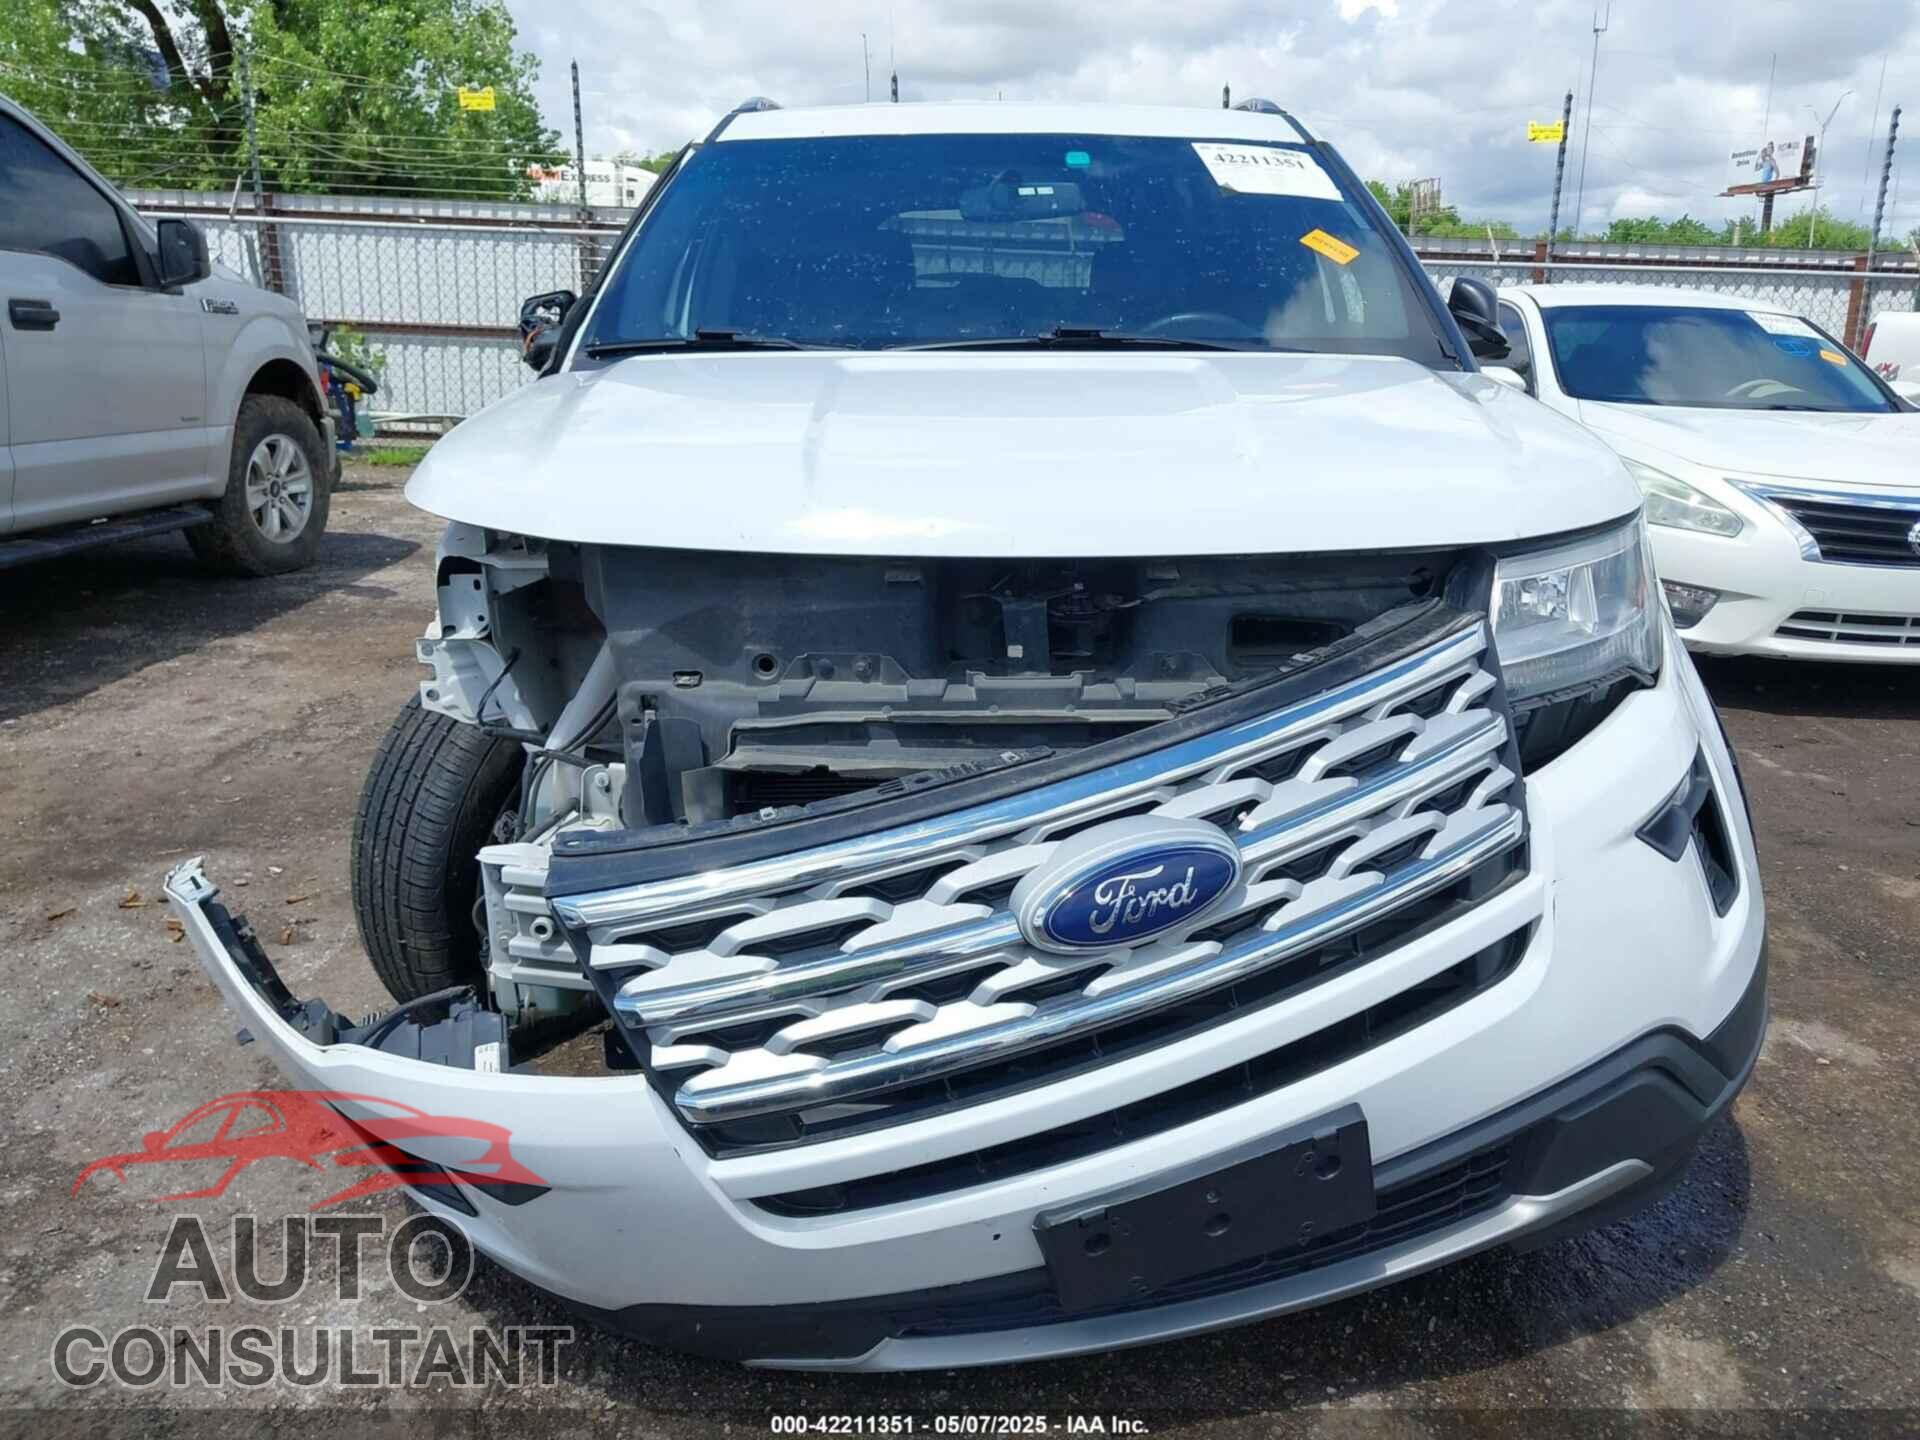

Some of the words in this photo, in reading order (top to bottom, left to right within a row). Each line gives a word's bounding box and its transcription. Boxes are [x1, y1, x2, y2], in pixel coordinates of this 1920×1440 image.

[1214, 153, 1305, 169] 42211351
[560, 169, 611, 183] EXRESS
[1088, 864, 1198, 934] Ford
